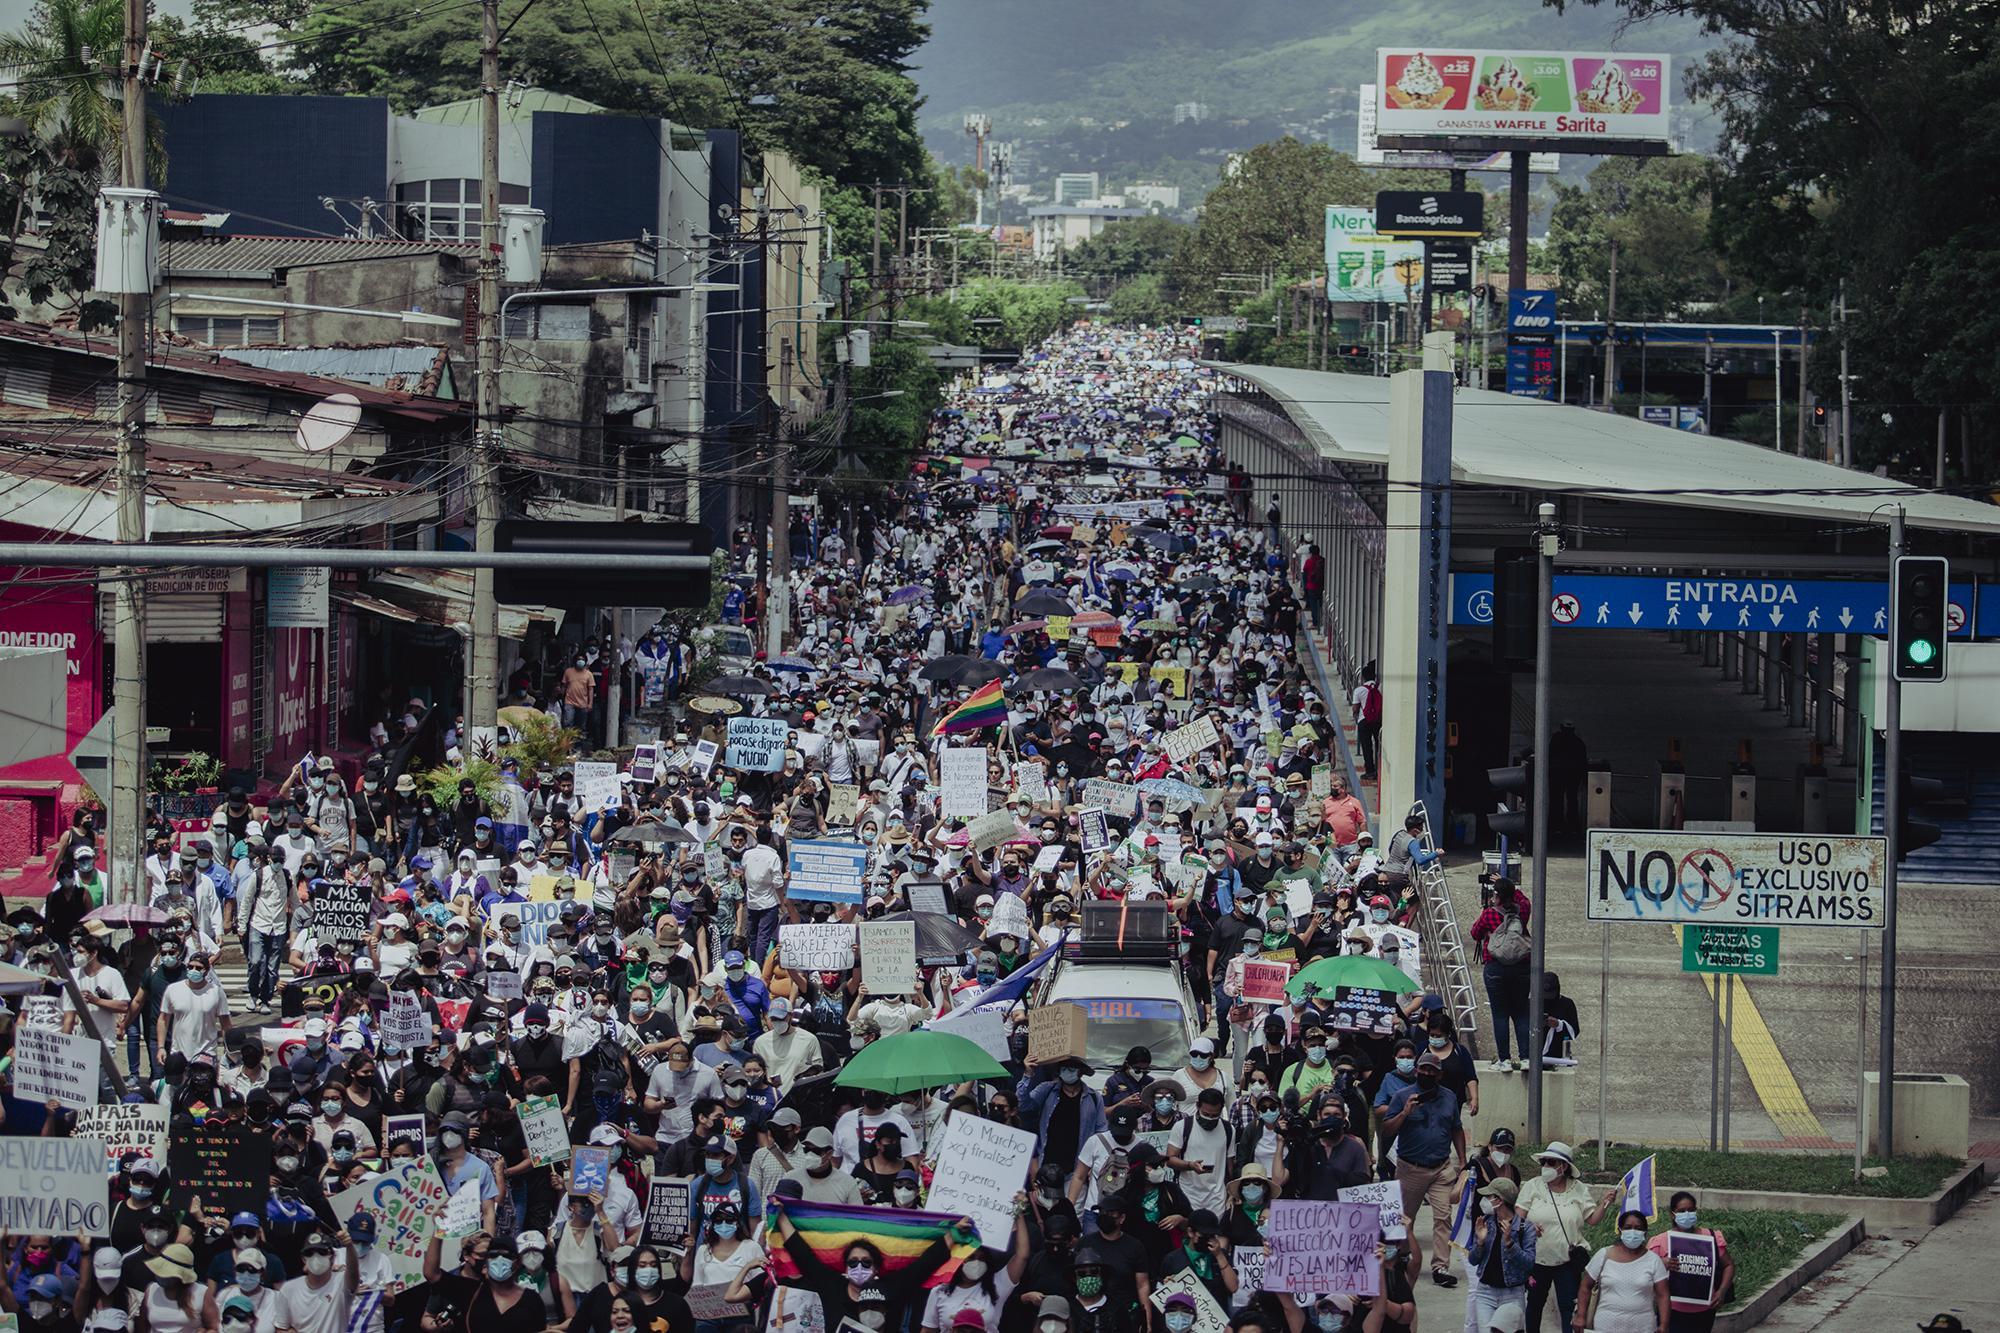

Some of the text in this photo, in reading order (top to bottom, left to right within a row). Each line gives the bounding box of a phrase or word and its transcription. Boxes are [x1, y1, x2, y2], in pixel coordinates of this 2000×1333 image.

[1437, 115, 1606, 133] CANASTAS WAFFLE Sarita
[1513, 315, 1550, 327] UNO
[195, 580, 206, 591] DE
[208, 580, 229, 591] DIOS
[1665, 581, 1799, 604] ENTRADA
[0, 631, 77, 649] OMEDOR
[729, 721, 784, 736] Cuando se lee
[737, 751, 769, 766] MUCHO
[1778, 841, 1832, 867] USO
[1599, 849, 1677, 901] NO
[1740, 867, 1870, 892] EXCLUSIVO
[327, 886, 358, 900] MÁS
[314, 898, 371, 914] EDUCACIÓN
[521, 902, 560, 923] DIO
[1736, 893, 1873, 921] SITRAMSS
[313, 913, 365, 927] MENOS
[782, 925, 852, 938] A LA MIERDA
[783, 939, 829, 953] BUKELE
[787, 952, 849, 969] BITCOIN
[1694, 951, 1766, 968] VERDES
[20, 1029, 71, 1046] NO ES CHIVO
[19, 1039, 60, 1054] NEGOCIAR
[18, 1051, 29, 1060] LA
[54, 1056, 65, 1066] DE
[72, 1060, 86, 1071] LOS
[17, 1065, 79, 1085] SALVADOREÑOS
[17, 1082, 87, 1102] #BUKELEMARERO
[97, 1104, 141, 1119] PAIS
[137, 1132, 156, 1145] DE
[958, 1116, 1027, 1154] Yo Marcho
[18, 1175, 57, 1192] LO
[1345, 1189, 1360, 1197] NO
[1275, 1203, 1341, 1232] ELECCIÓN
[651, 1232, 679, 1242] COLAPSO
[1270, 1229, 1374, 1254] REELECCIÓN PARA
[1288, 1254, 1303, 1275] ES
[1307, 1255, 1322, 1275] LA
